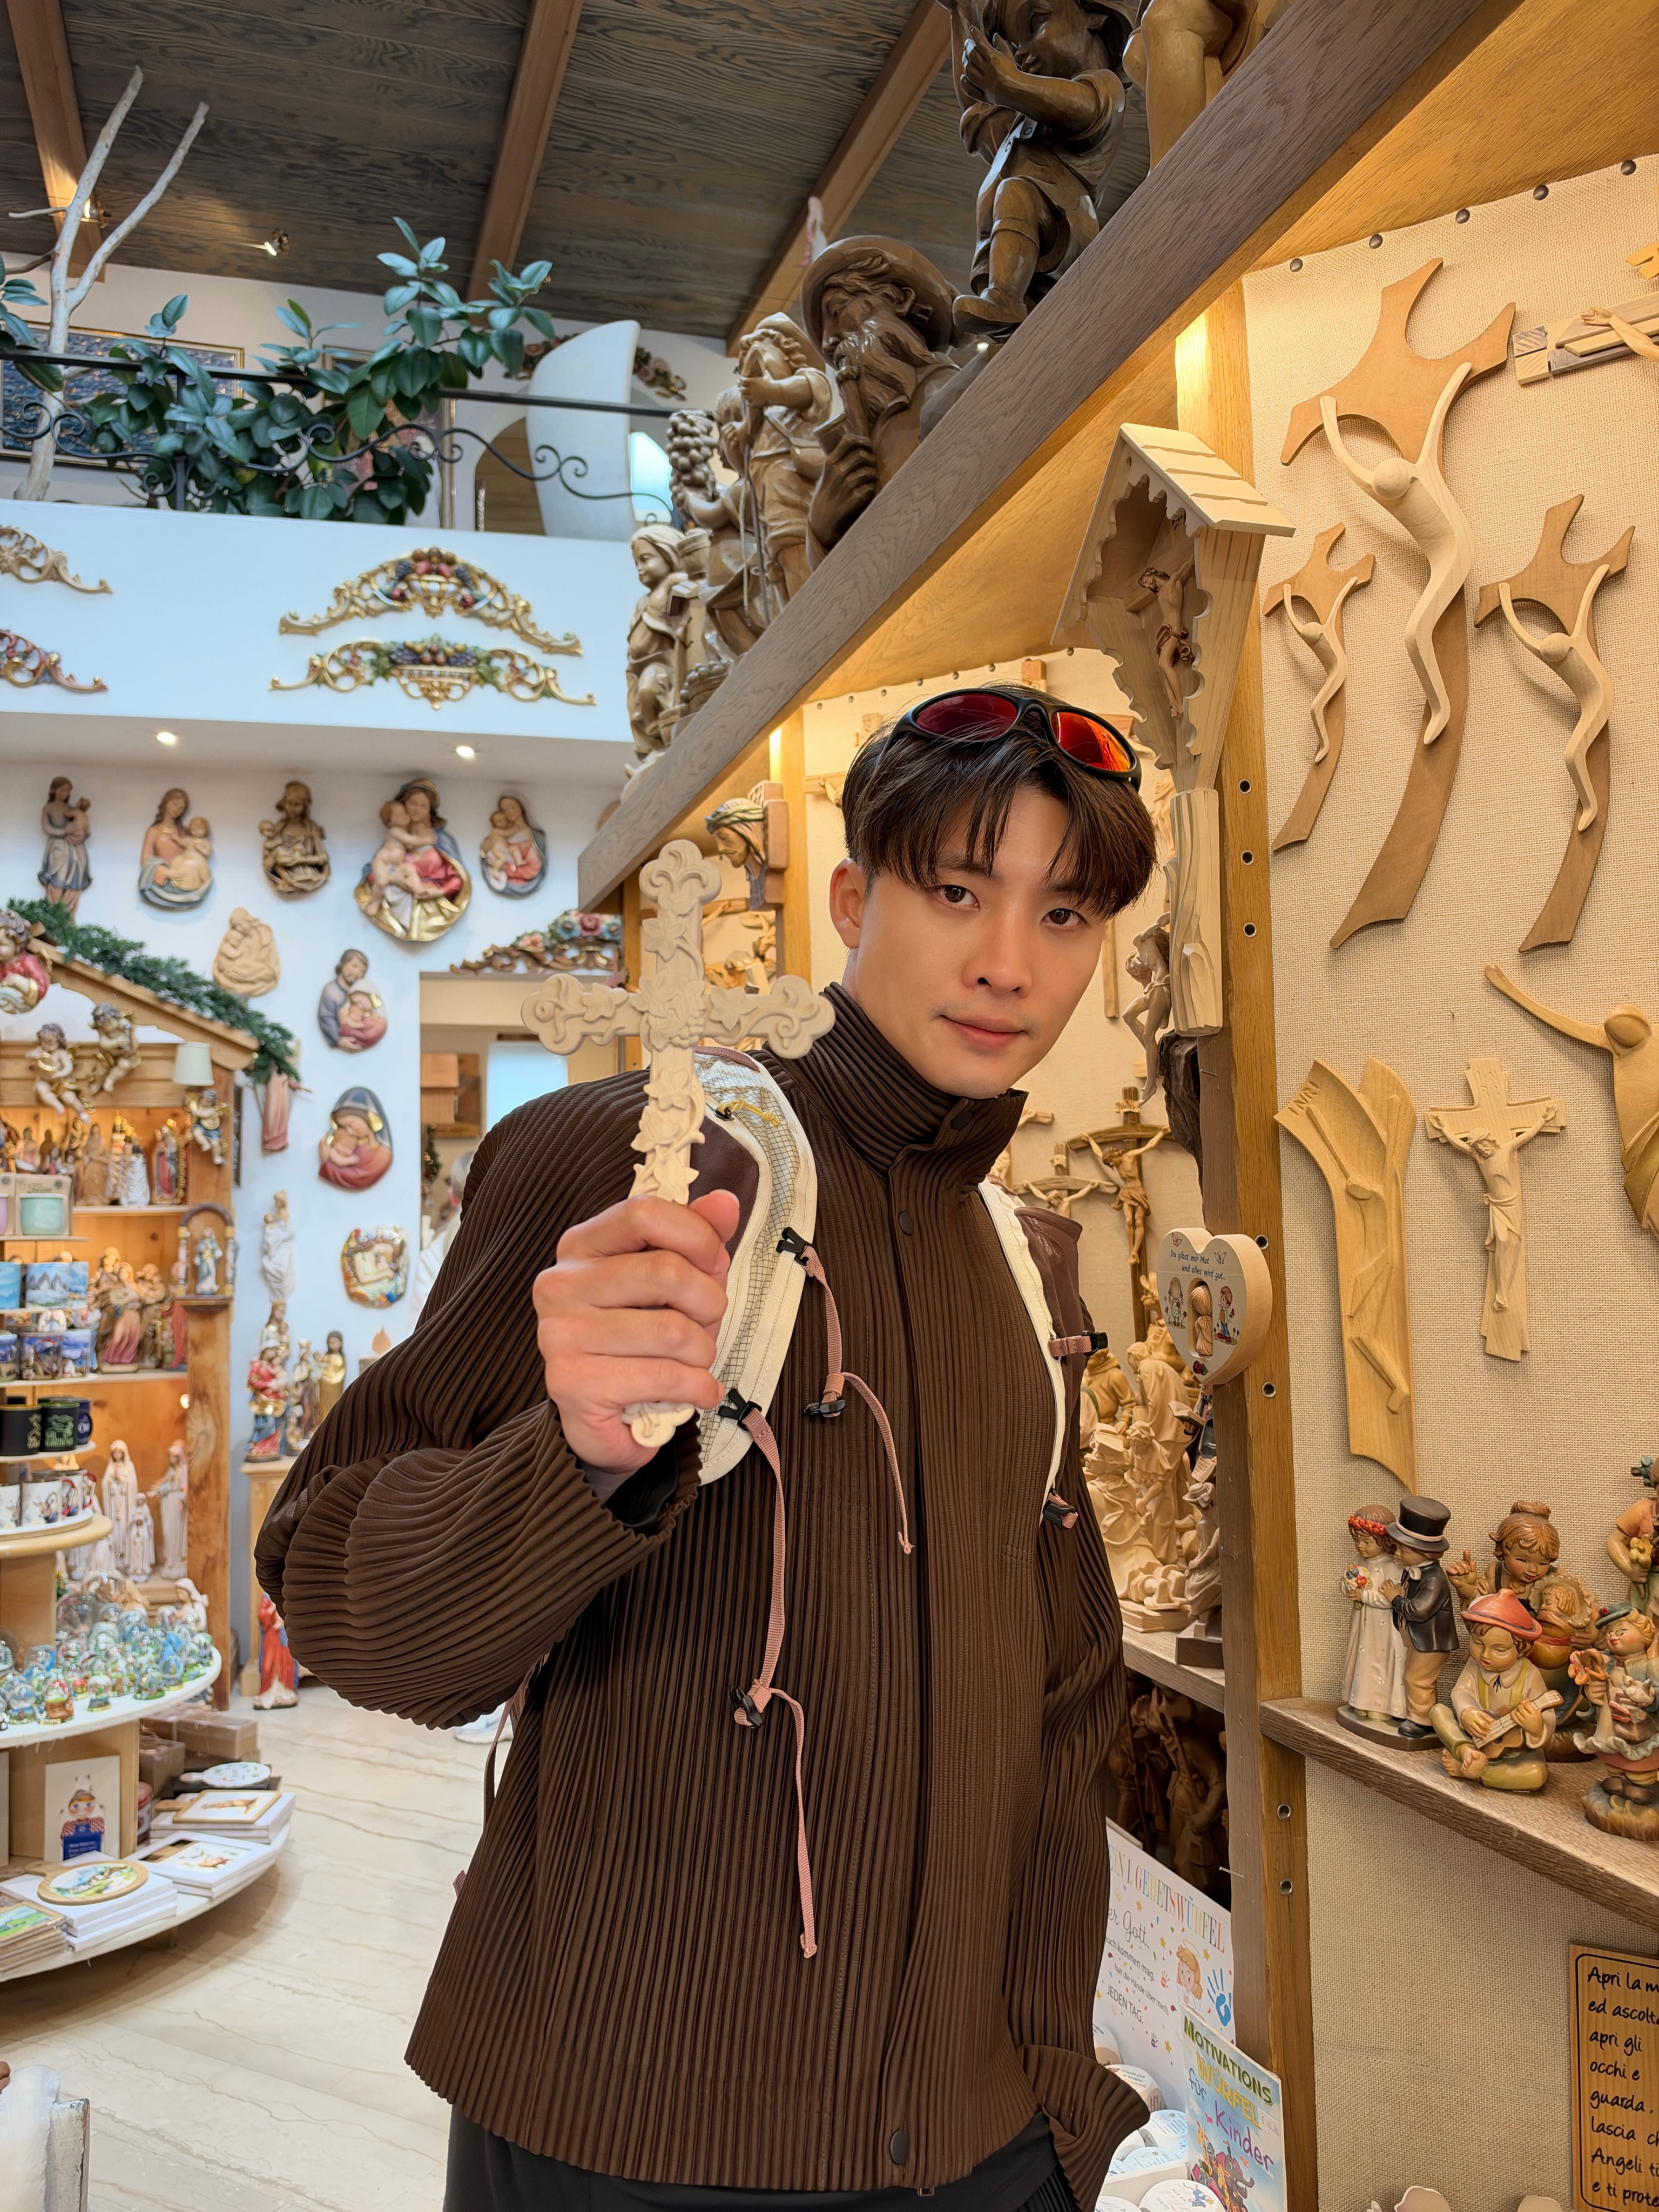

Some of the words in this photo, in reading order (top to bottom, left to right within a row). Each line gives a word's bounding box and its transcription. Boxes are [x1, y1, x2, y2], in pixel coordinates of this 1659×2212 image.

[1171, 1249, 1176, 1258] Du
[1178, 1251, 1189, 1261] gibst
[1200, 1256, 1210, 1264] Mut
[1182, 1264, 1190, 1272] und
[1191, 1266, 1202, 1275] alles
[1204, 1269, 1213, 1277] wird
[1135, 1865, 1225, 1953] GEBETSWÜRFEL
[1117, 1943, 1141, 1969] kommen
[1115, 1963, 1123, 1977] halt
[1131, 1978, 1145, 1995] Hände
[1145, 1989, 1157, 2003] über
[1587, 1966, 1621, 1990] Apri
[1627, 1972, 1641, 1990] la
[1107, 1984, 1128, 2011] JEDEN
[1128, 2001, 1144, 2025] TAG.
[1588, 1998, 1607, 2014] ed
[1589, 2031, 1618, 2050] apri
[1624, 2035, 1642, 2056] gli
[1184, 2015, 1273, 2106] MOTIVATIONS
[1590, 2060, 1627, 2079] occhi
[1632, 2069, 1640, 2080] e
[1189, 2068, 1207, 2100] für
[1196, 2052, 1262, 2130] WÜRFEL
[1591, 2116, 1636, 2140] lascia
[1591, 2147, 1642, 2175] Angeli
[1592, 2181, 1601, 2193] e
[1607, 2182, 1617, 2198] ti
